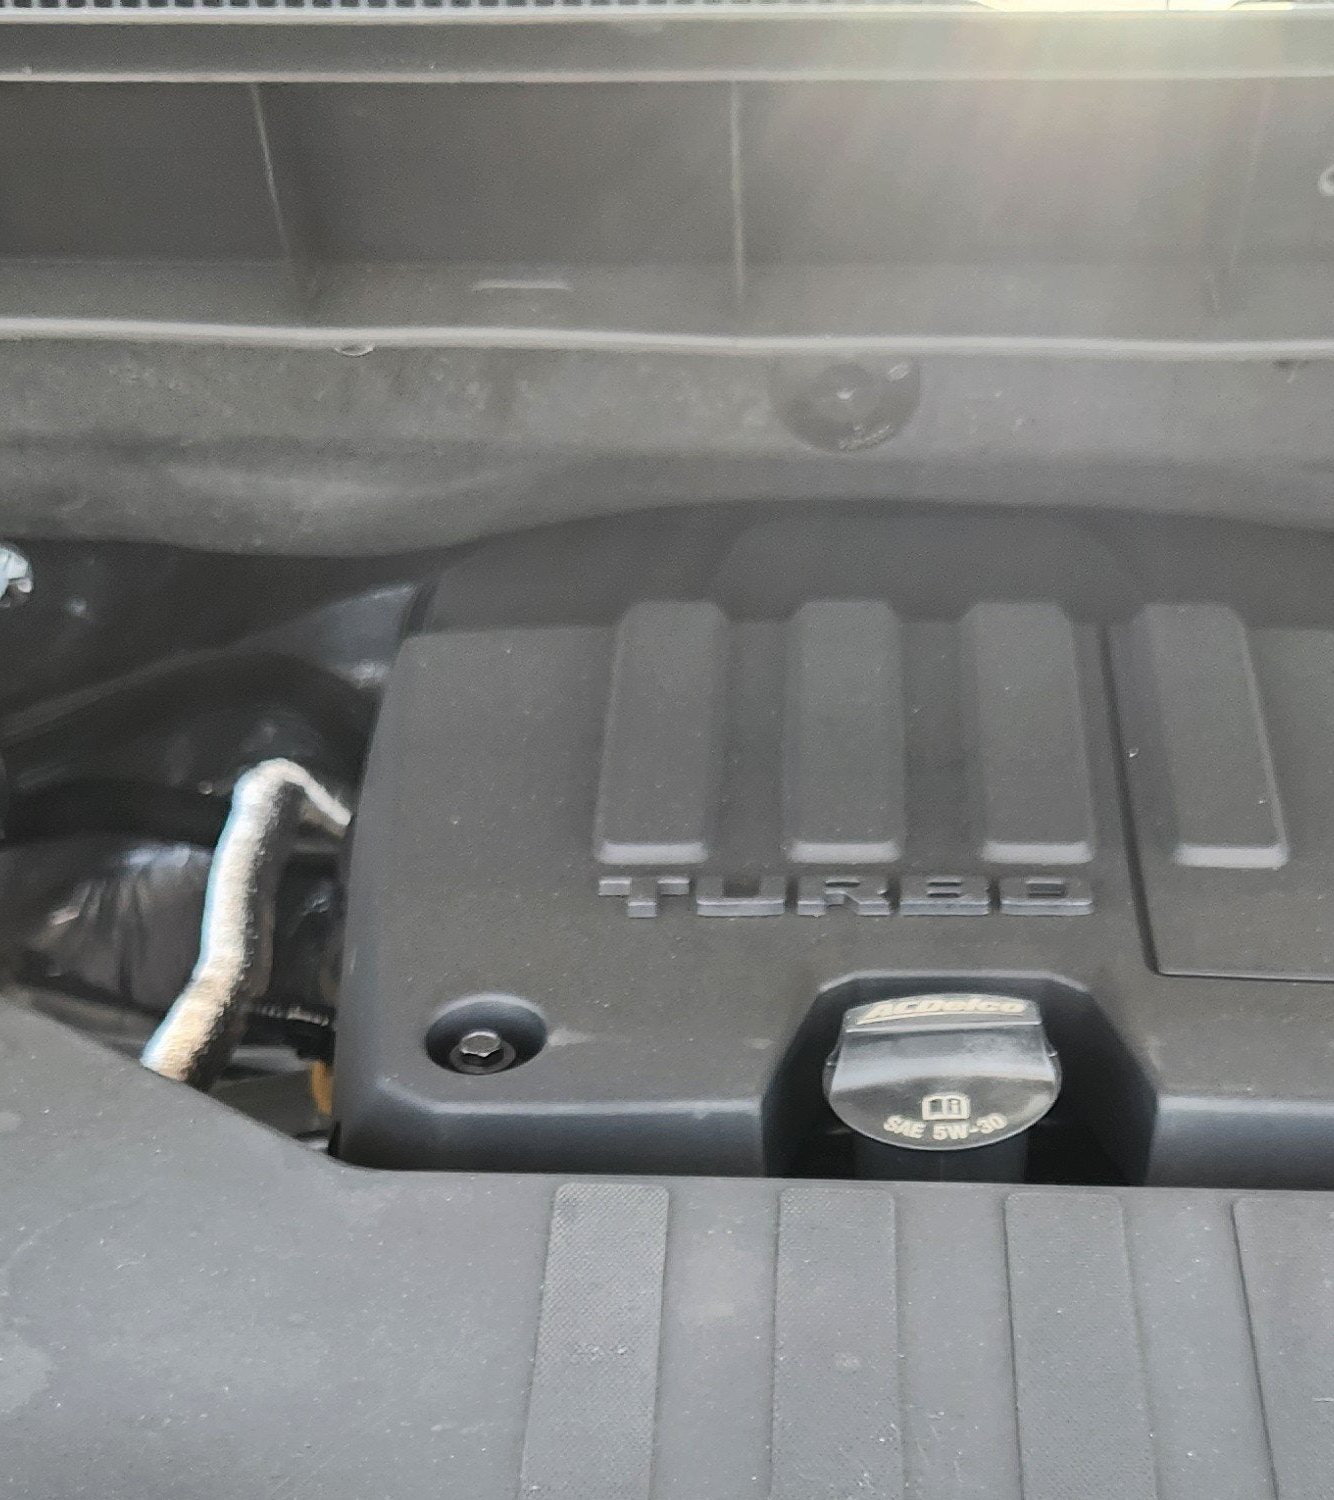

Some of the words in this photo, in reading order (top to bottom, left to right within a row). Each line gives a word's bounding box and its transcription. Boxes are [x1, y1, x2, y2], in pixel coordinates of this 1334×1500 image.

[598, 876, 1095, 918] TURBO
[856, 999, 1027, 1025] ACDelco
[883, 1114, 927, 1139] SAE
[932, 1112, 1008, 1140] 5W-30
